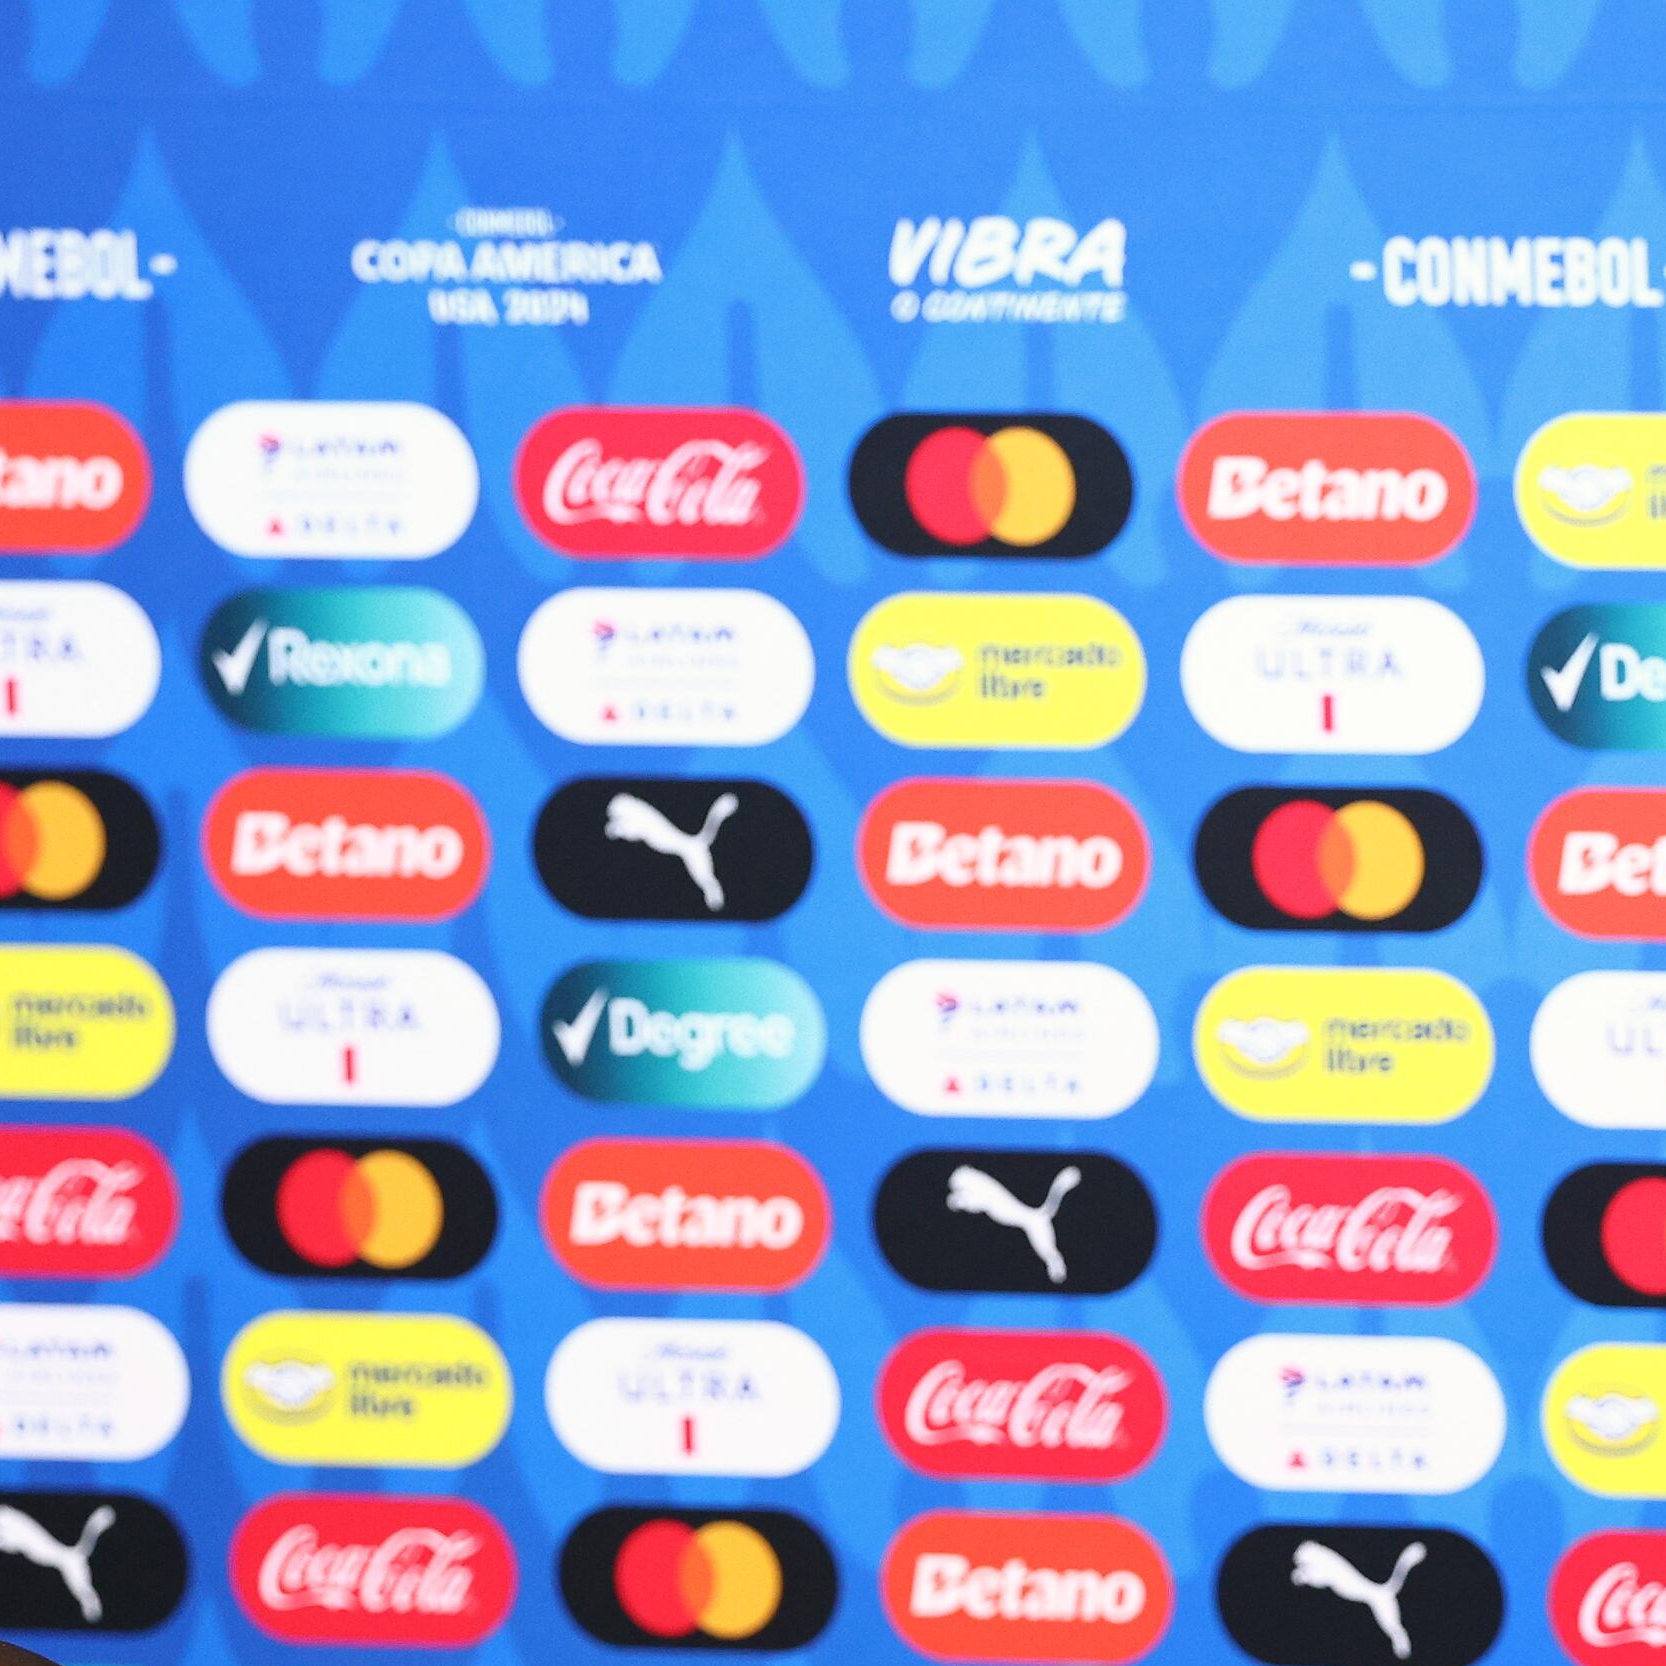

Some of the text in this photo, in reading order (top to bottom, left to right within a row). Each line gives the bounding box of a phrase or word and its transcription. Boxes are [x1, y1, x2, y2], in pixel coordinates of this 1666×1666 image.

[351, 239, 663, 285] COPA AMERICA
[889, 216, 1127, 288] VIBRA
[1382, 236, 1666, 308] CONMEBOL
[428, 288, 590, 326] USA 2024
[922, 289, 1128, 324] CONTINENTE
[1208, 456, 1447, 521] Betano
[267, 630, 447, 685] Rexona
[1257, 647, 1404, 682] ULTRA
[232, 812, 463, 878] Betano
[887, 822, 1122, 888] Betano
[610, 997, 792, 1071] Degree
[570, 1182, 803, 1249] Betano
[620, 1370, 762, 1404] ULTRA
[911, 1554, 1145, 1622] Betano
